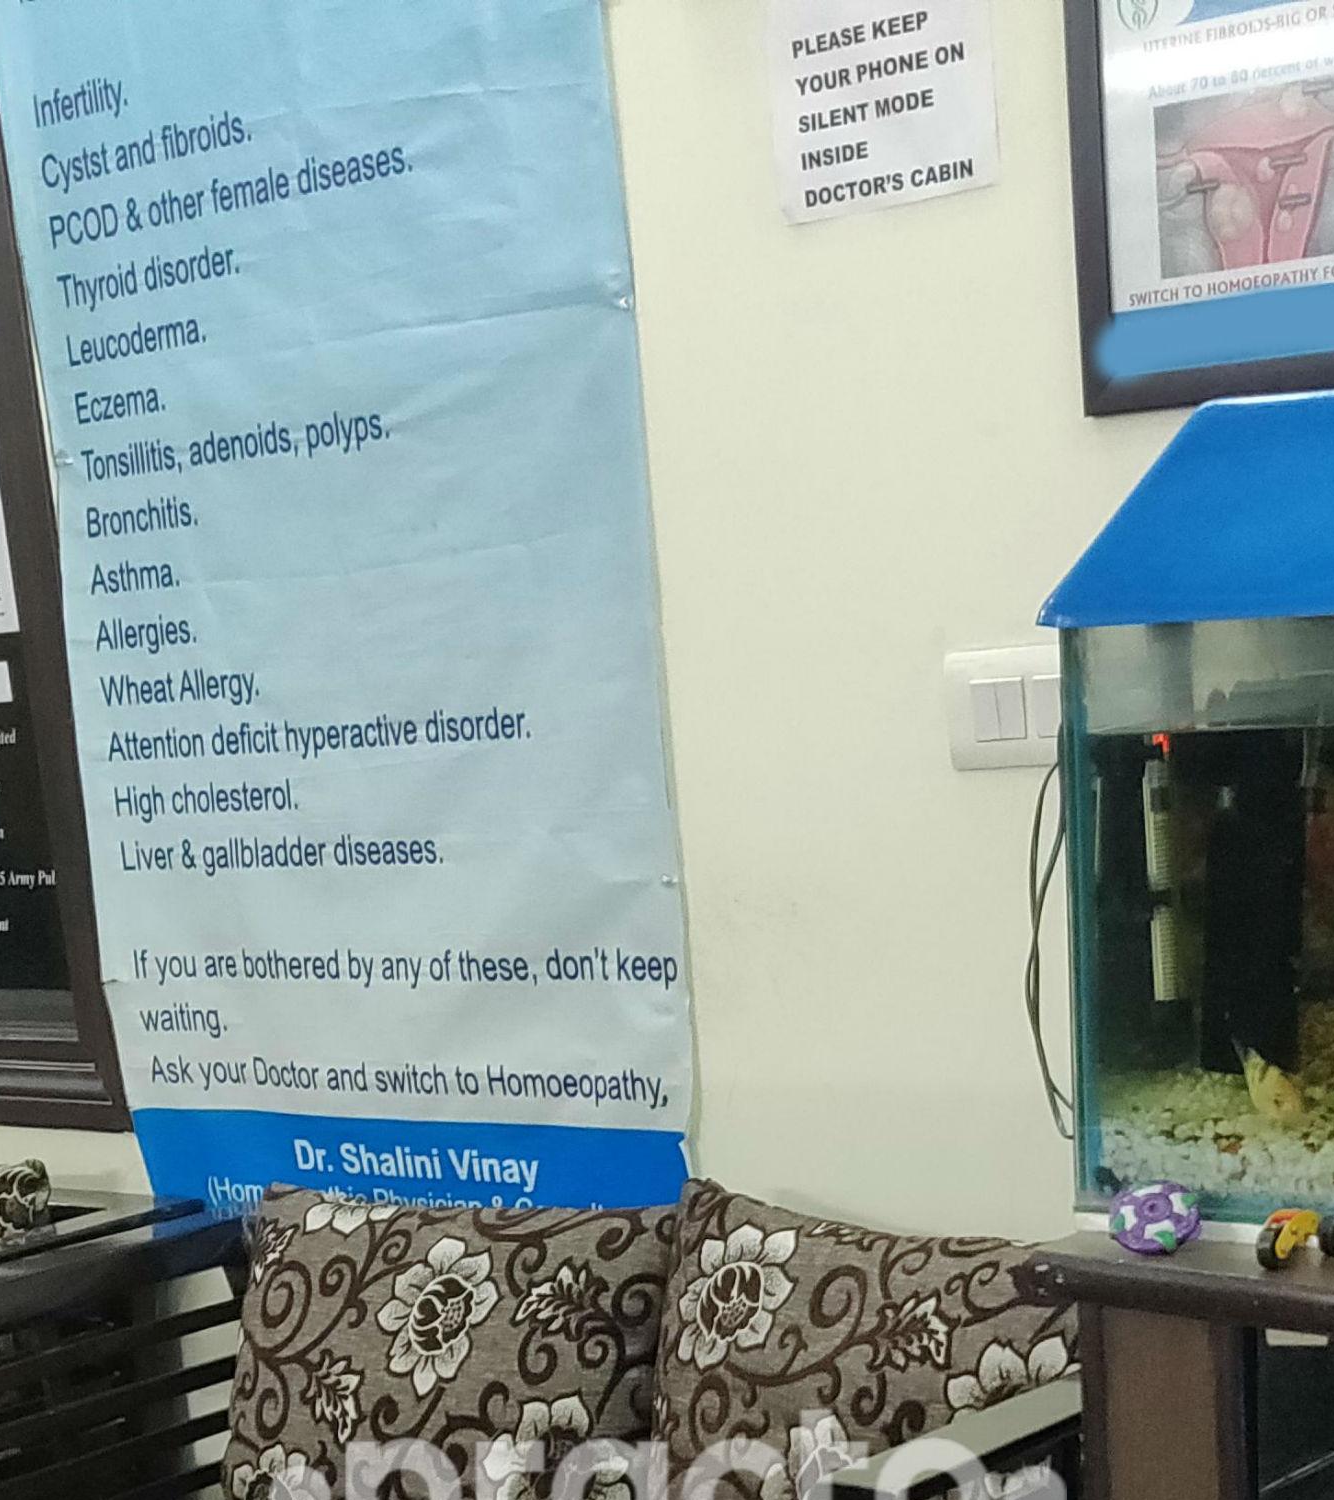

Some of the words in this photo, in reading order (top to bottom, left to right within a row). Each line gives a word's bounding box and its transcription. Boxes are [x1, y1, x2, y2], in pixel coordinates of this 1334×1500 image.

[792, 25, 866, 59] PLEASE
[872, 11, 928, 40] KEEP
[1306, 6, 1326, 23] OR
[796, 68, 851, 96] YOUR
[856, 50, 928, 83] PHONE
[935, 42, 965, 65] ON
[1191, 76, 1208, 92] 70
[1213, 74, 1226, 88] to
[33, 78, 128, 128] Infertility.
[798, 103, 869, 134] SILENT
[875, 88, 934, 119] MODE
[114, 130, 156, 171] and
[161, 110, 252, 162] fibroids.
[801, 141, 869, 171] INSIDE
[49, 203, 118, 249] PCOD
[125, 197, 143, 232] &
[148, 187, 205, 227] other
[210, 166, 290, 214] female
[297, 144, 414, 196] diseases.
[804, 173, 904, 208] DOCTOR'S
[910, 158, 973, 187] CABIN
[57, 262, 138, 313] Thyroid
[143, 244, 240, 292] disorder.
[1128, 288, 1180, 308] SWITCH
[1183, 283, 1203, 299] TO
[1207, 267, 1319, 296] HOMOEOPATHY
[66, 318, 207, 367] Leucoderma.
[74, 386, 167, 425] Eczema.
[80, 441, 183, 482] Tonsillitis,
[189, 420, 299, 467] adenoids,
[305, 410, 390, 459] polyps.
[86, 496, 199, 538] Bronchitis.
[90, 560, 180, 595] Asthma.
[95, 614, 198, 655] Allergies.
[100, 672, 175, 707] Wheat
[180, 668, 260, 706] Allergy.
[108, 728, 205, 763] Attention
[210, 722, 280, 756] deficit
[284, 713, 418, 760] hyperactive
[425, 706, 532, 744] disorder.
[113, 785, 166, 824] High
[171, 777, 299, 814] cholesterol.
[120, 840, 174, 872] Liver
[181, 838, 197, 870] &
[202, 836, 326, 877] gallbladder
[333, 834, 444, 866] diseases.
[7, 871, 36, 890] Army
[133, 948, 151, 980] If
[154, 955, 197, 986] you
[204, 954, 237, 980] are
[241, 948, 341, 982] bothered
[347, 948, 374, 989] by
[380, 955, 422, 990] any
[429, 949, 452, 983] of
[458, 949, 538, 988] these,
[545, 947, 609, 983] don't
[615, 947, 678, 991] keep
[139, 1004, 228, 1039] waiting.
[150, 1055, 193, 1085] Ask
[197, 1060, 247, 1091] your
[253, 1056, 319, 1091] Doctor
[326, 1061, 367, 1092] and
[375, 1062, 449, 1095] switch
[454, 1065, 480, 1097] to
[486, 1064, 669, 1109] Homoeopathy,
[293, 1138, 334, 1173] Dr.
[339, 1142, 443, 1180] Shalini
[447, 1148, 539, 1194] Vinay
